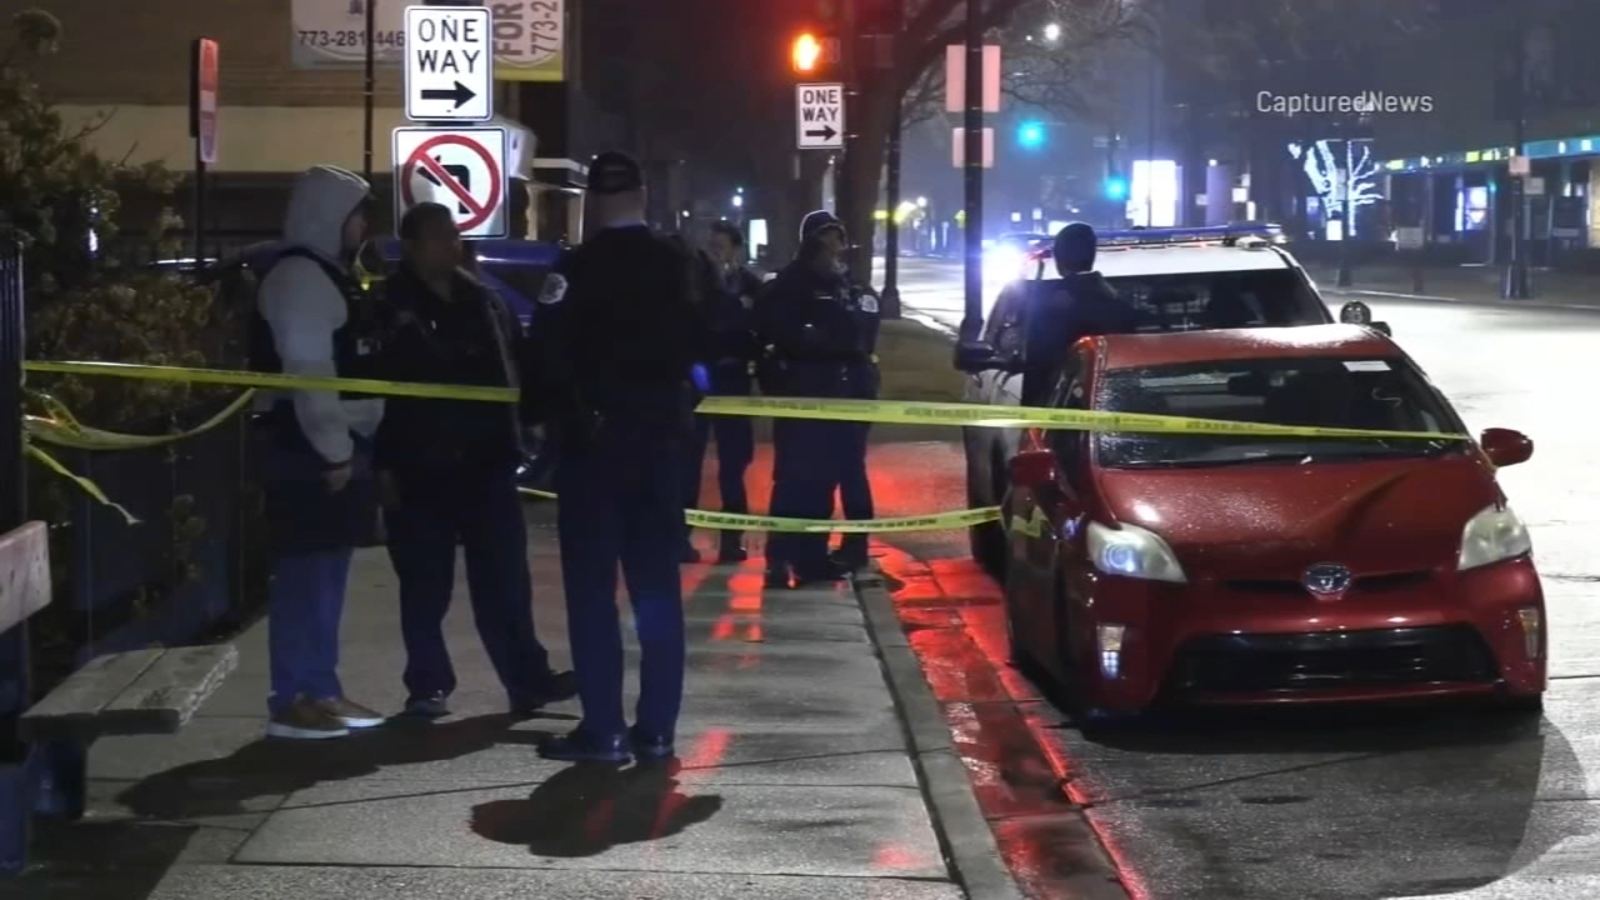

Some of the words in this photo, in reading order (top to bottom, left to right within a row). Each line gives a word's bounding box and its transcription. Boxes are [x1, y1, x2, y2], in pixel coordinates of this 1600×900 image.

[298, 30, 405, 47] 773-281446
[418, 18, 479, 42] ONE
[493, 3, 523, 55] FOR
[530, 1, 558, 55] 773-2
[417, 50, 480, 74] WAY
[803, 90, 838, 104] ONE
[802, 107, 838, 122] WAY
